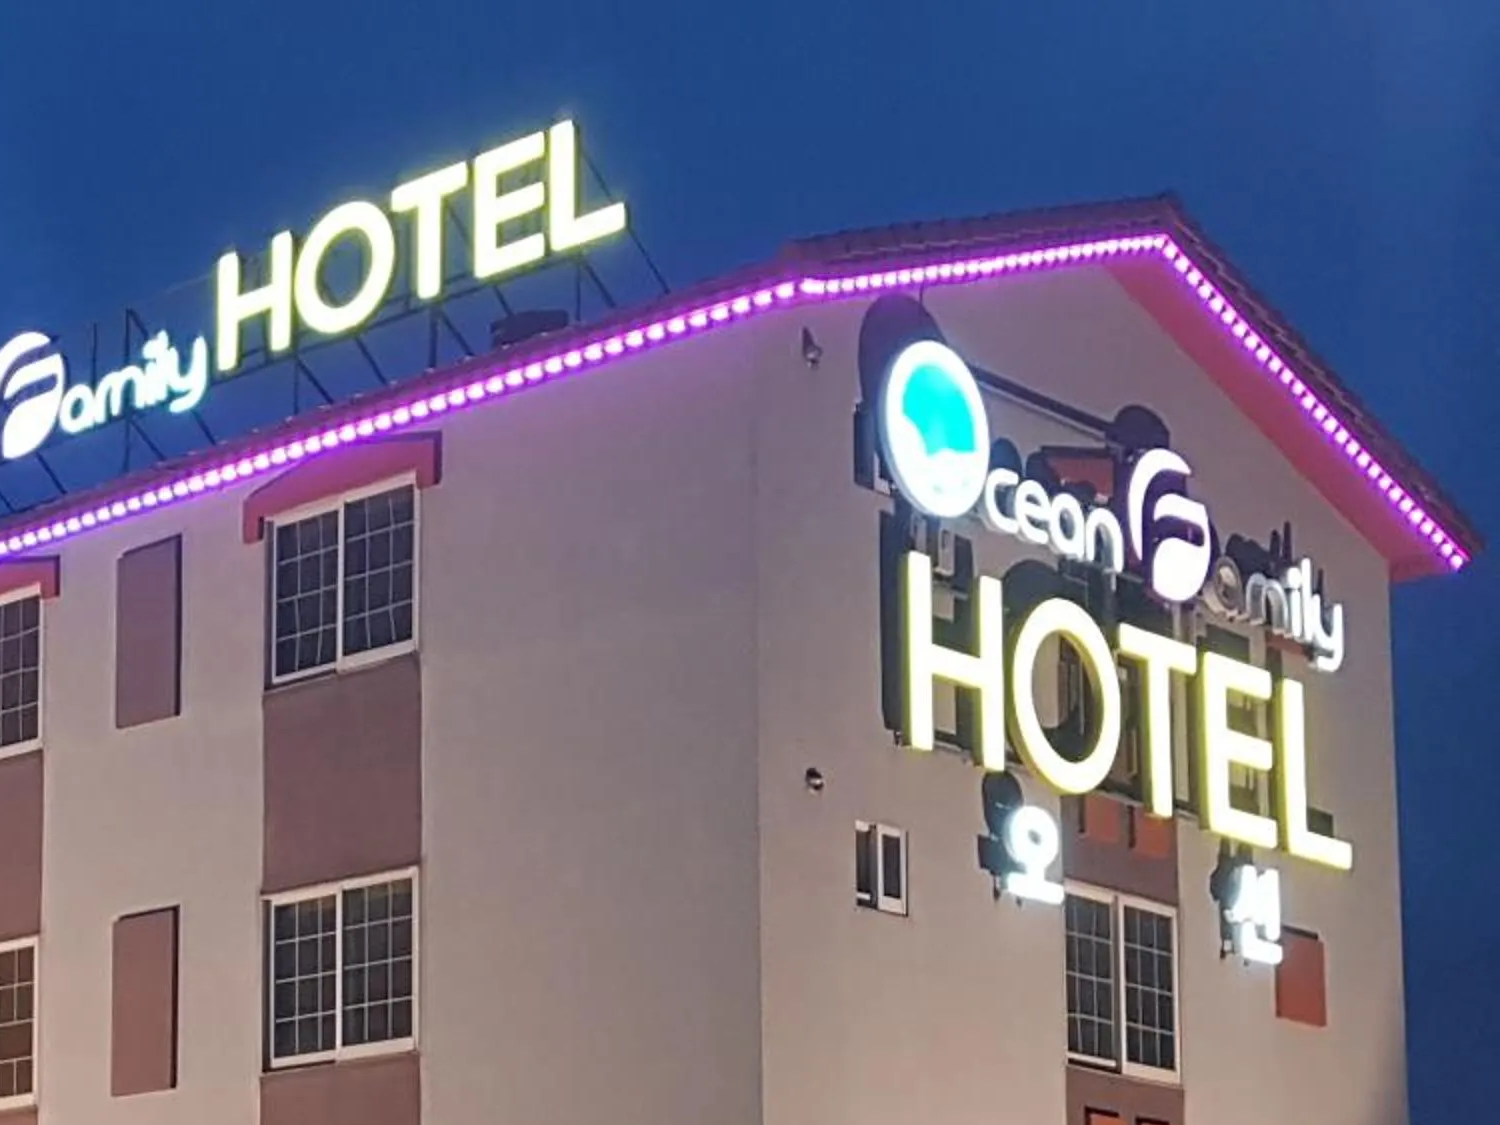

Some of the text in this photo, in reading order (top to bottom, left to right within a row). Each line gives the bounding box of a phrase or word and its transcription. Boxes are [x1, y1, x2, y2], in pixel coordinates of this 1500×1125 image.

[217, 119, 626, 371] HOTEL
[884, 340, 1125, 574] Ocean
[904, 550, 1352, 870] HOTEL
